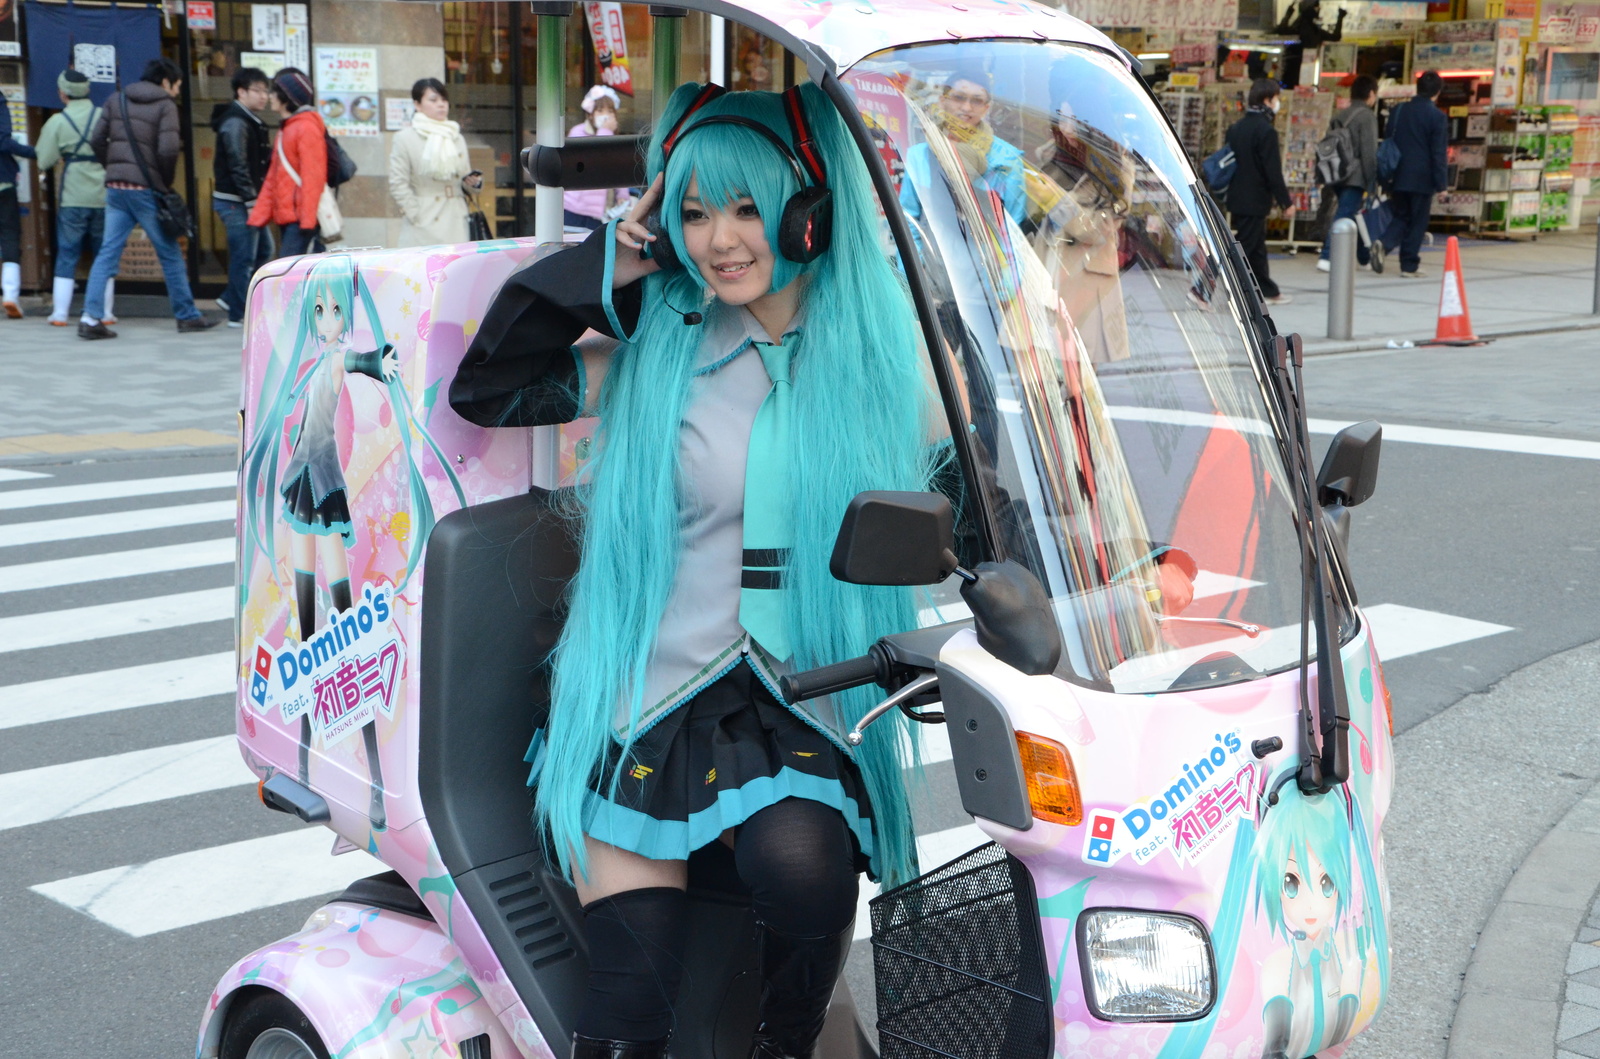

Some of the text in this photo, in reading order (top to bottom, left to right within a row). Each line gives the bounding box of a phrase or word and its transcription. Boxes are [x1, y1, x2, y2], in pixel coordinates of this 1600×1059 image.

[855, 78, 900, 97] TAKARADA
[277, 588, 389, 691] Domino's
[313, 643, 399, 725] 初音ミク
[282, 692, 309, 719] feat.
[325, 708, 370, 741] HATSUNE MIKU
[1122, 732, 1242, 841] Domino's
[1171, 763, 1256, 850] 初音ミク
[1135, 835, 1168, 861] feat.
[1191, 819, 1233, 860] HATSUNE MIKU
